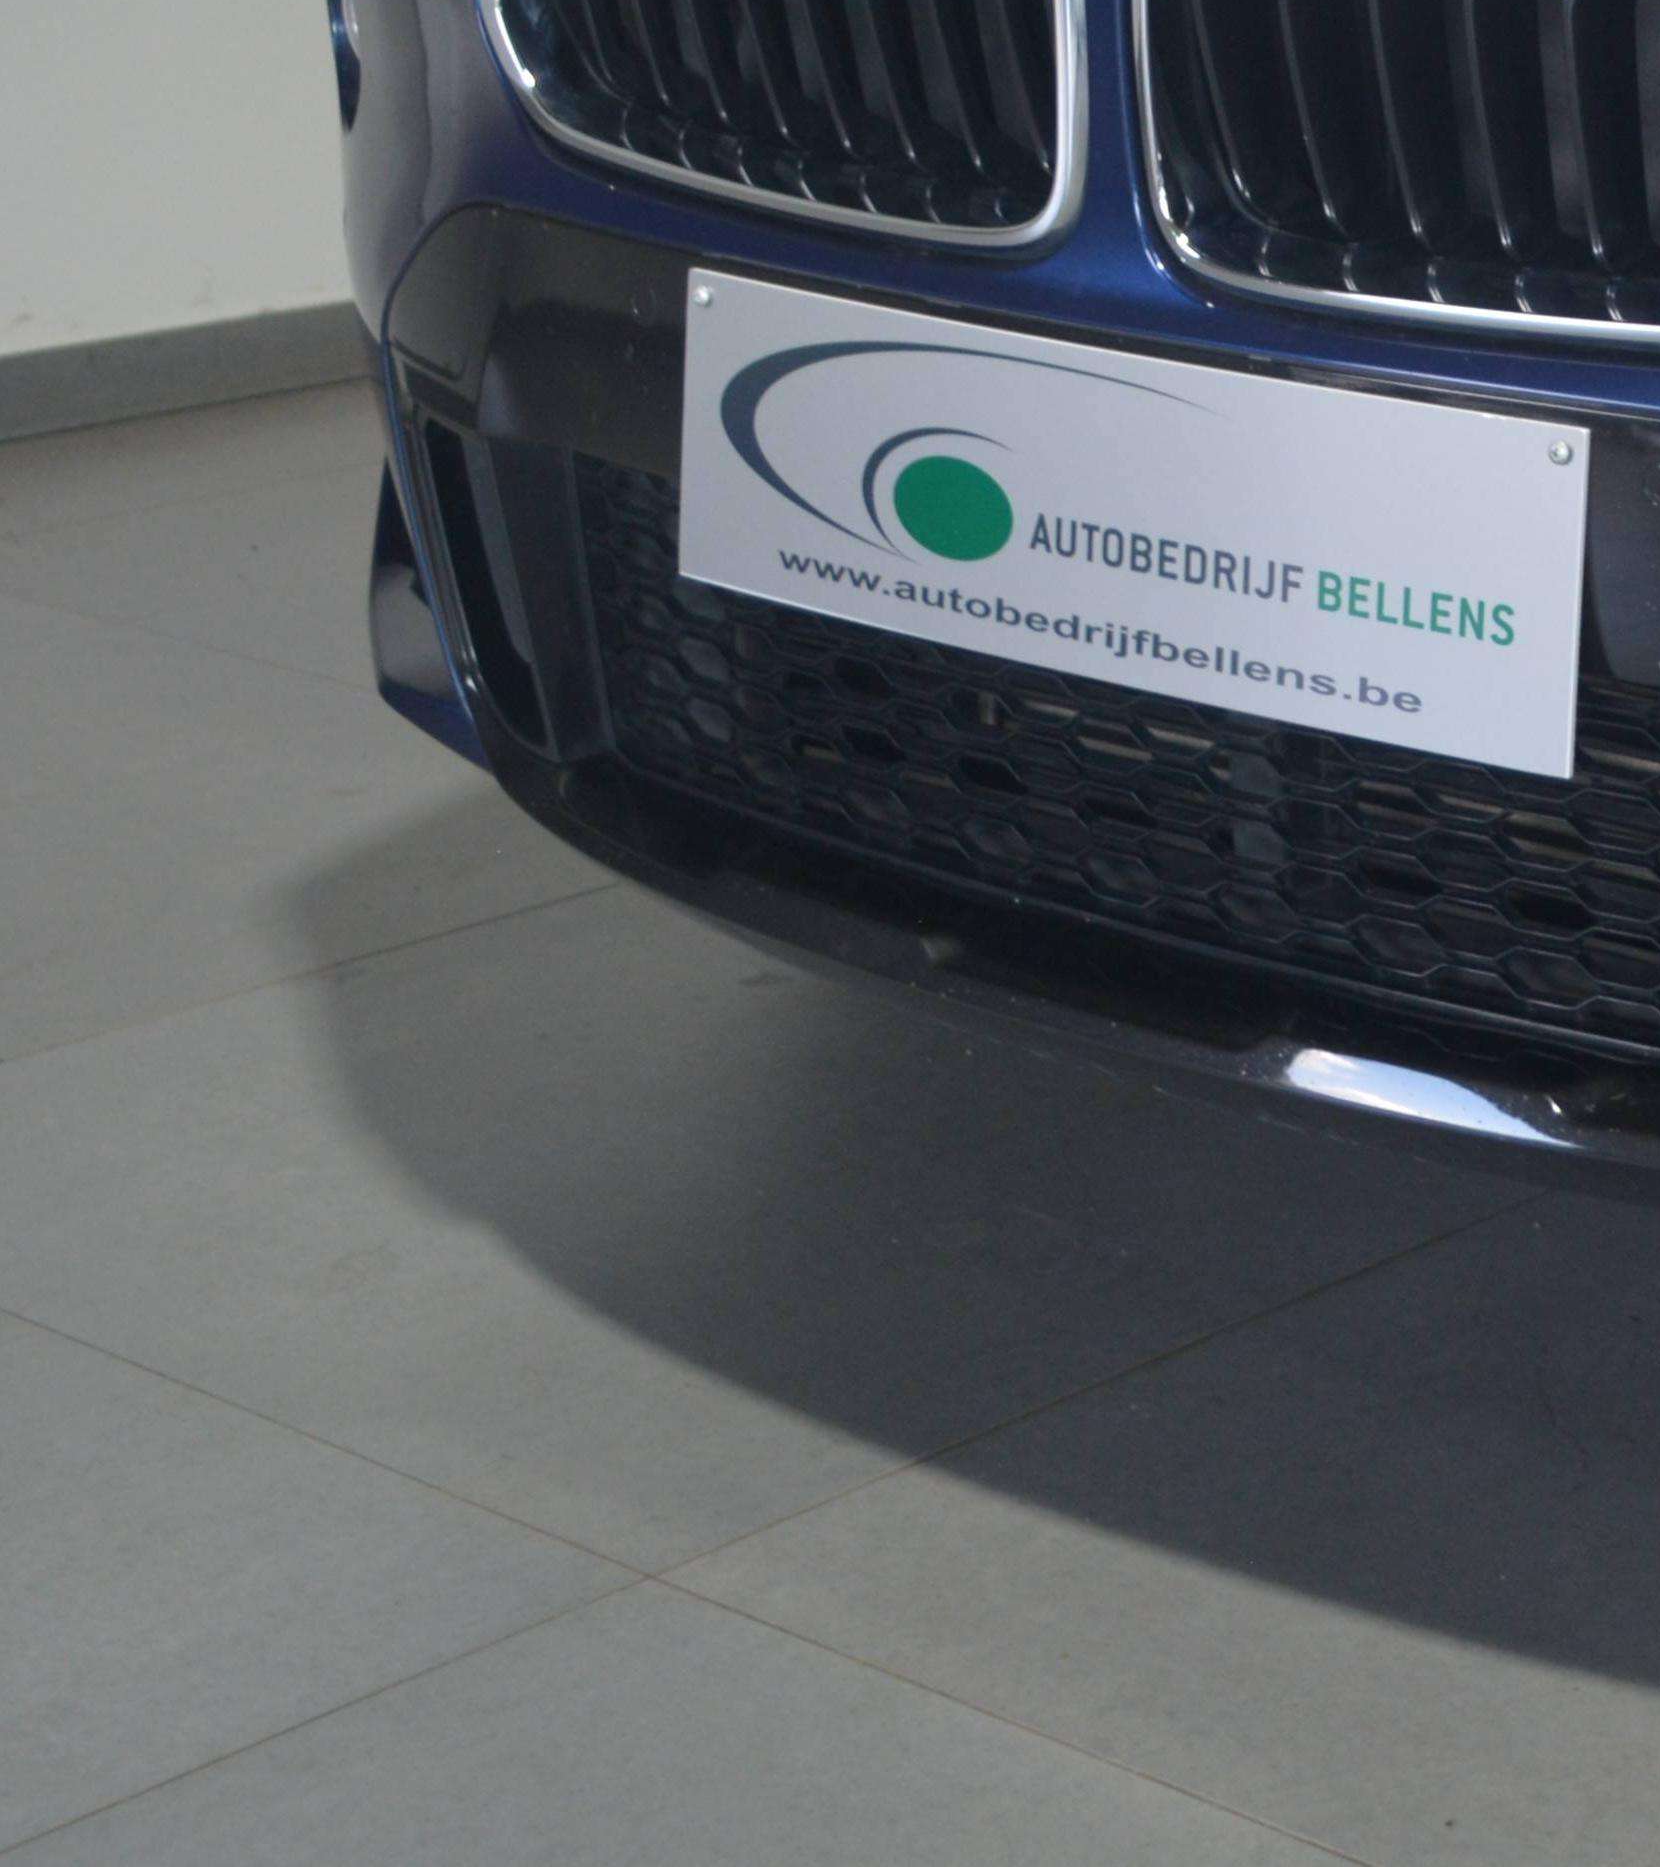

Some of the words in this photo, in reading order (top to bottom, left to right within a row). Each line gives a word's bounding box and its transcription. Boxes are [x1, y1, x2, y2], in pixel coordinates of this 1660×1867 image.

[779, 548, 1423, 714] www.autobedrijfbellens.be
[1030, 513, 1302, 603] AUTOBEDRIJF
[1318, 570, 1516, 646] BELLENS
